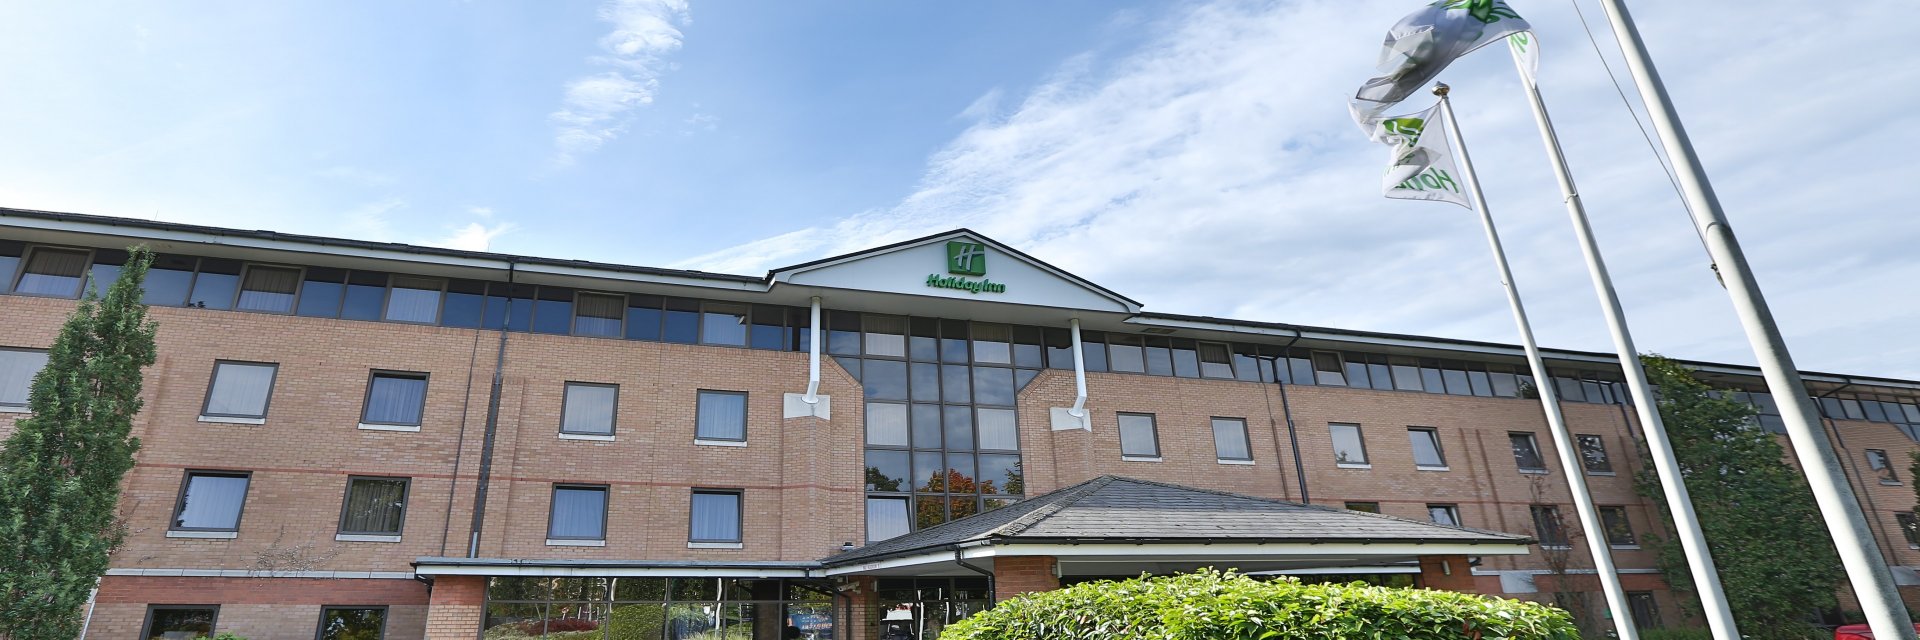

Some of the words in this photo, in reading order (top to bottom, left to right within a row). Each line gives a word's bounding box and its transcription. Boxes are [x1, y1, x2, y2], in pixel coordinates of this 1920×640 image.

[954, 245, 985, 271] H
[926, 273, 981, 294] Holiday
[982, 279, 1006, 293] Inn
